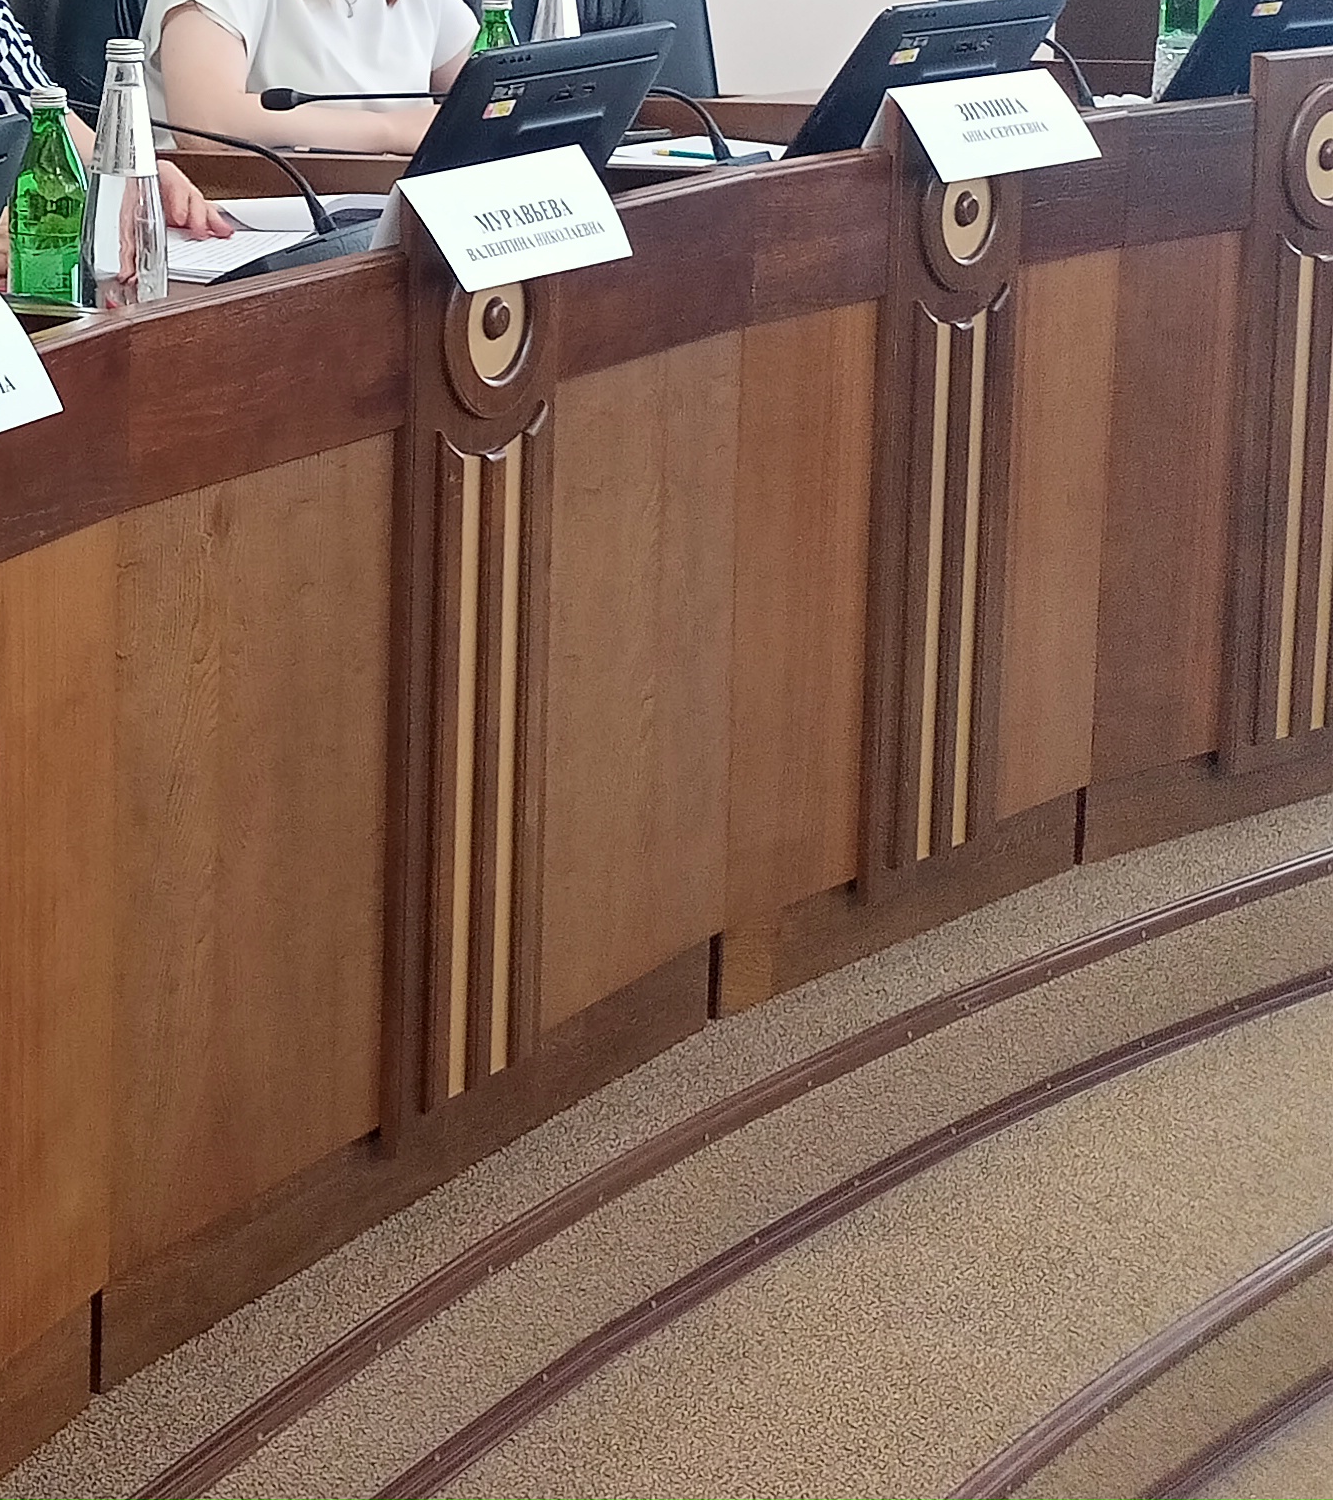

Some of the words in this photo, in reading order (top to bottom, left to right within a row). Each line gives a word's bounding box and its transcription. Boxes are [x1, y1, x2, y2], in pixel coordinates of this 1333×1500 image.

[473, 197, 574, 234] МУРАВЬЕВА
[465, 235, 537, 262] ВАЛЕНТИНА
[533, 220, 606, 248] НИКОЛАЕВНА
